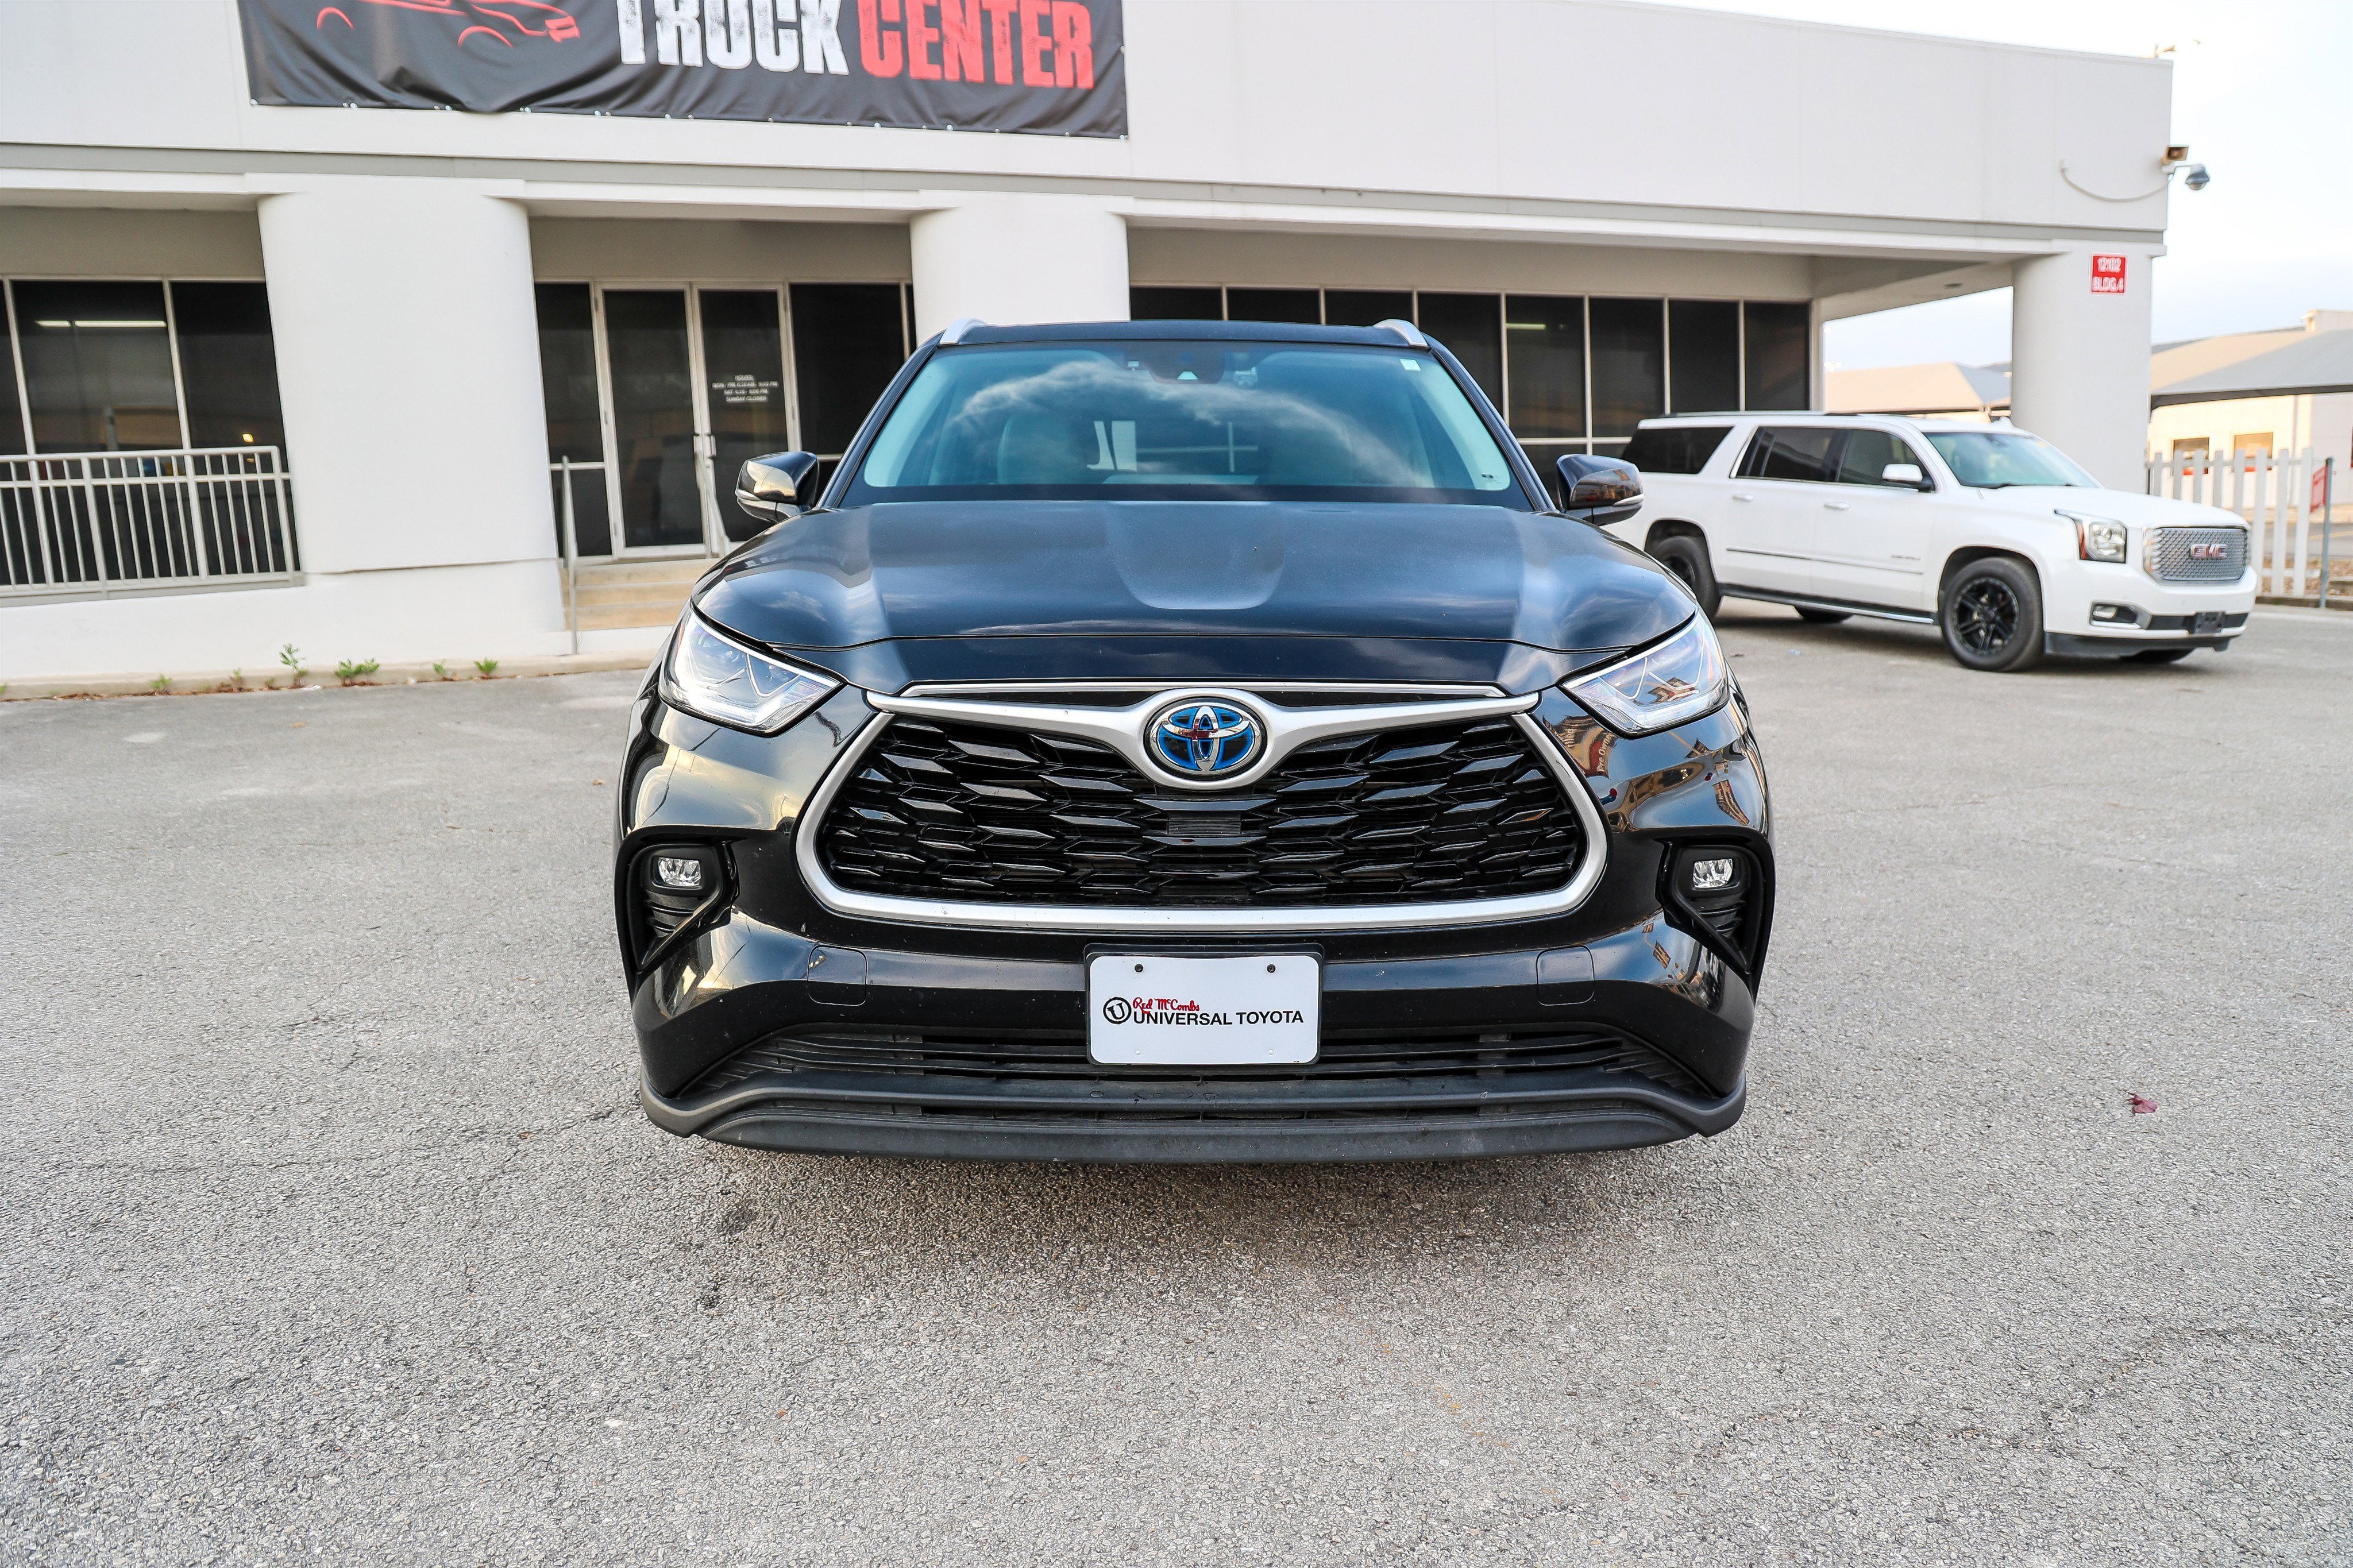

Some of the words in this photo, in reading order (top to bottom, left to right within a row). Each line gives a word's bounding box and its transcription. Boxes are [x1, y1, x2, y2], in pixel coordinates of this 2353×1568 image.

[616, 0, 850, 75] TRUCK
[857, 0, 1094, 90] CENTER
[2190, 543, 2228, 558] GMC
[1132, 997, 1153, 1014] Red
[1154, 998, 1199, 1011] McCombs
[1133, 1011, 1233, 1026] UNIVERSAL
[1236, 1010, 1304, 1025] TOYOTA
